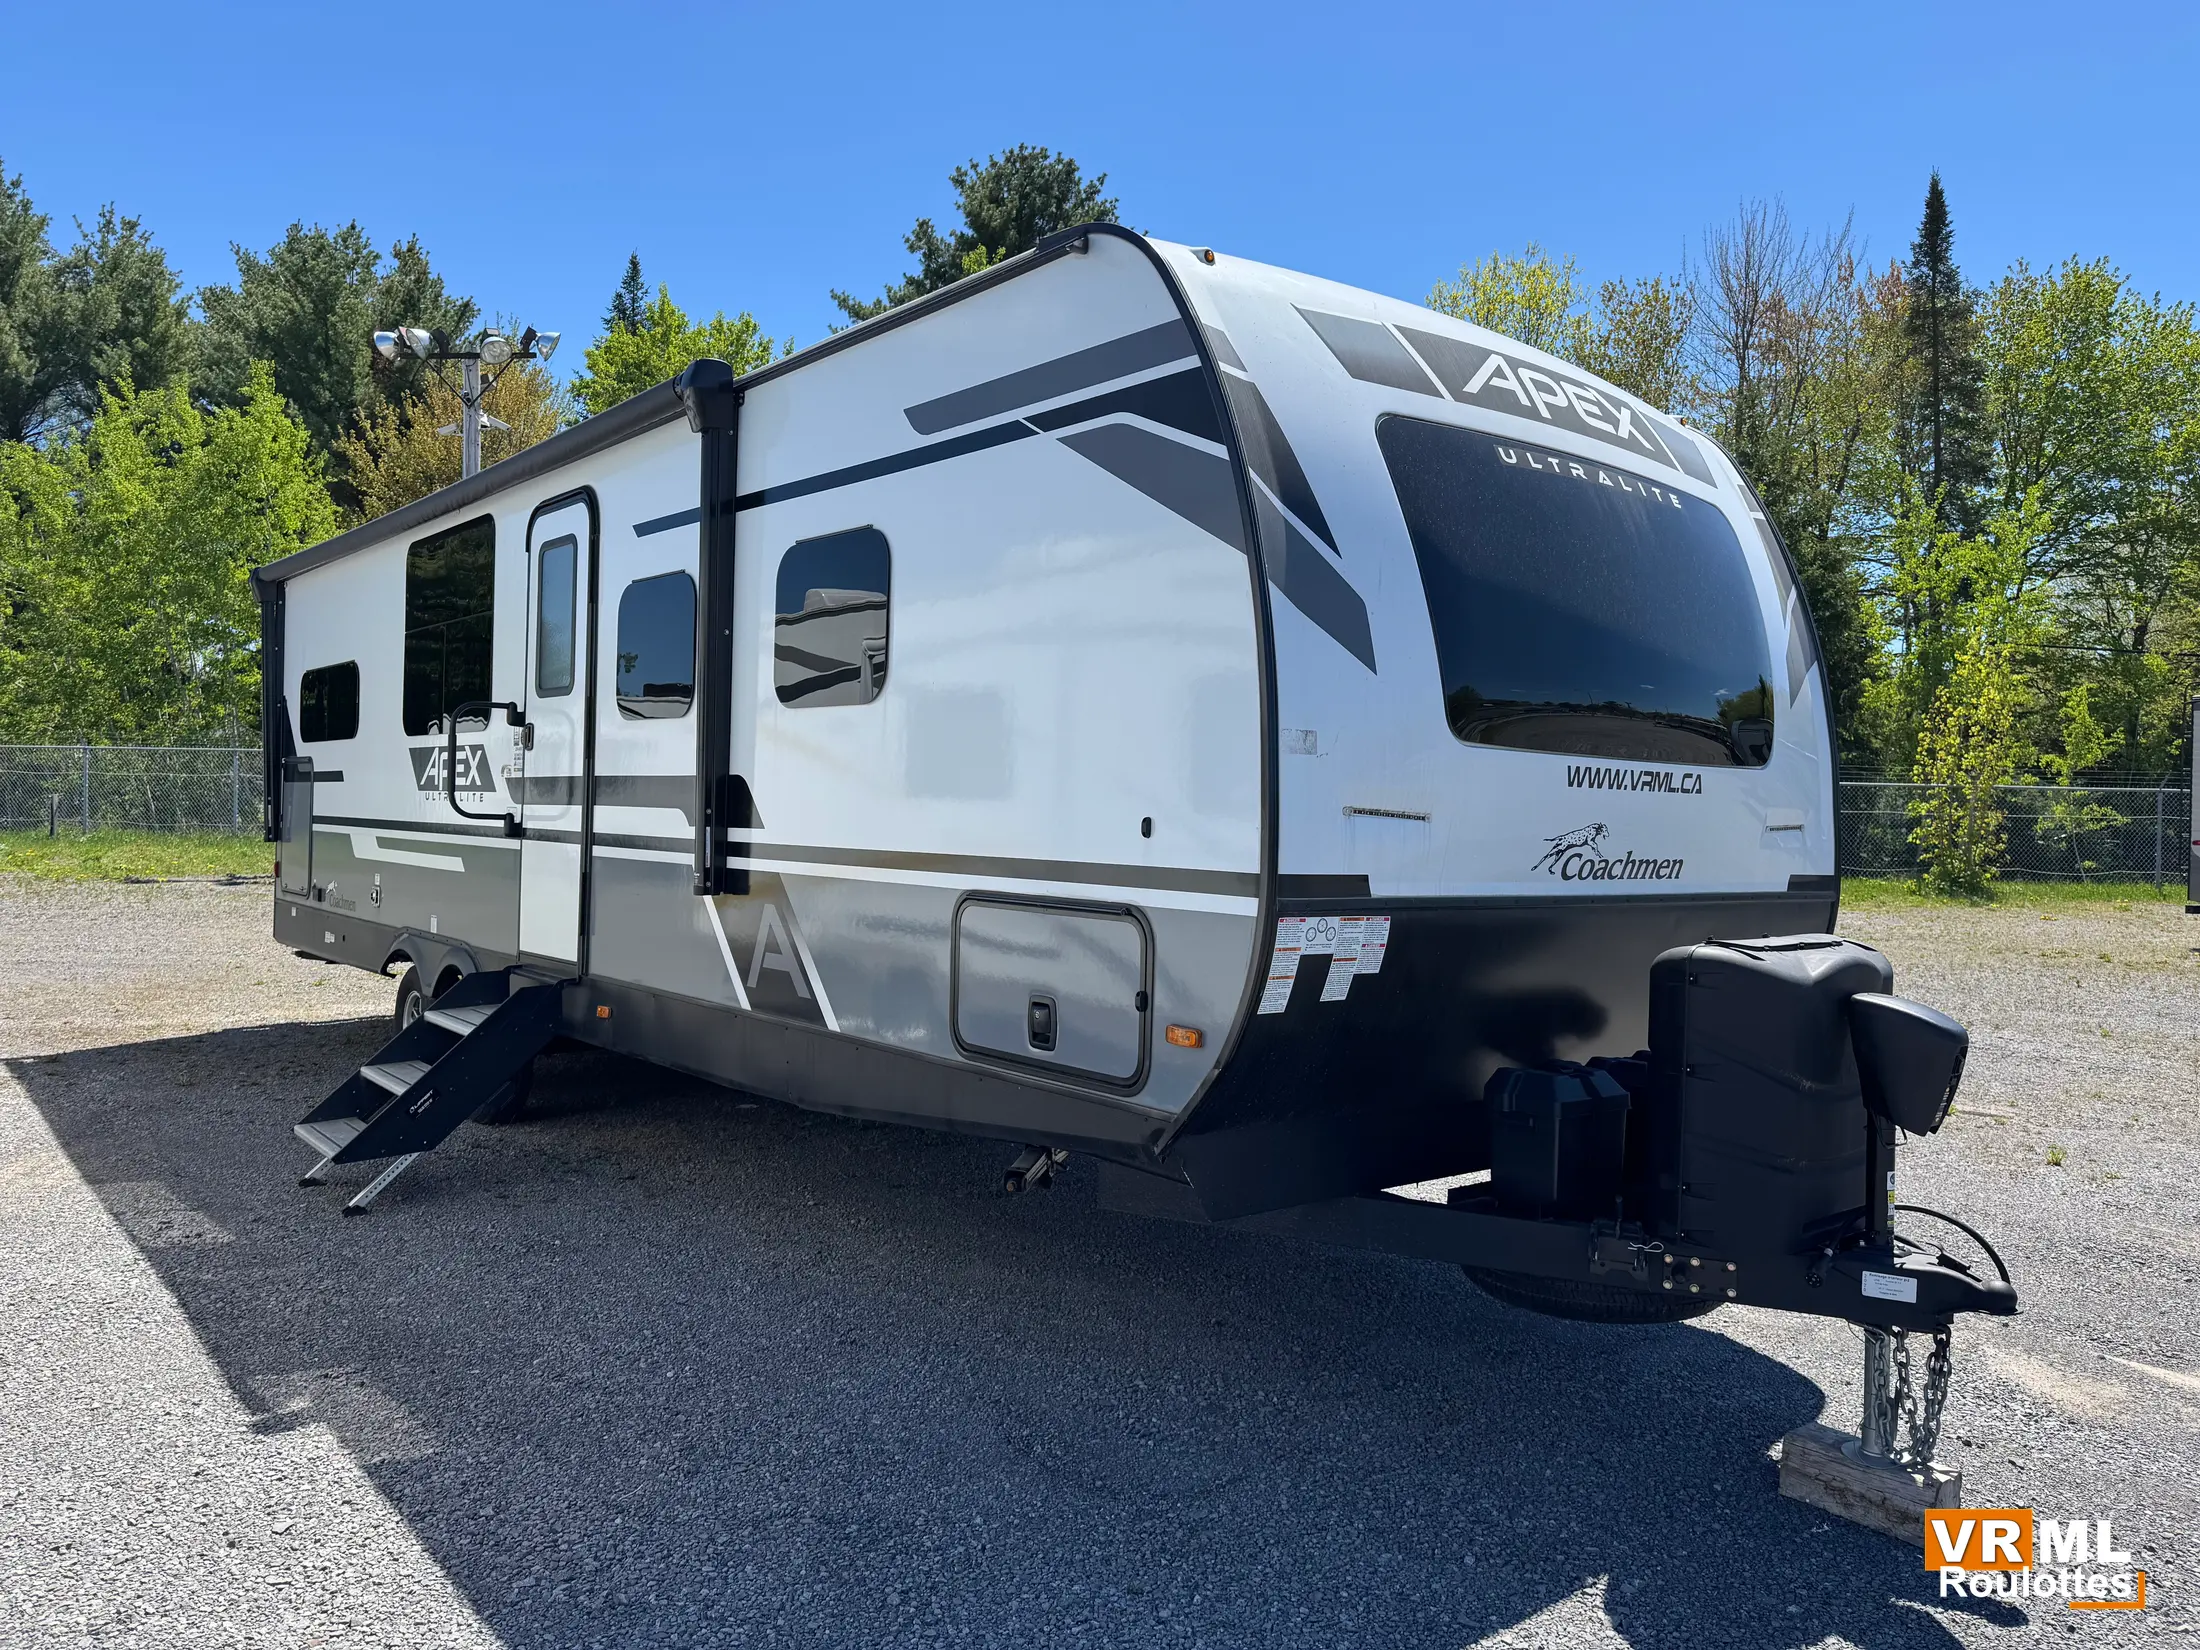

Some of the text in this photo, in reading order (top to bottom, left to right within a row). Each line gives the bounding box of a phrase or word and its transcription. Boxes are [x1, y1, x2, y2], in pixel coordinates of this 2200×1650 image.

[1462, 353, 1655, 452] APEX
[1498, 447, 1682, 508] ULTRALITE
[1567, 765, 1702, 795] WWW.VRML.CA
[425, 792, 484, 803] ULTRLITE
[1561, 851, 1684, 881] Coachmen
